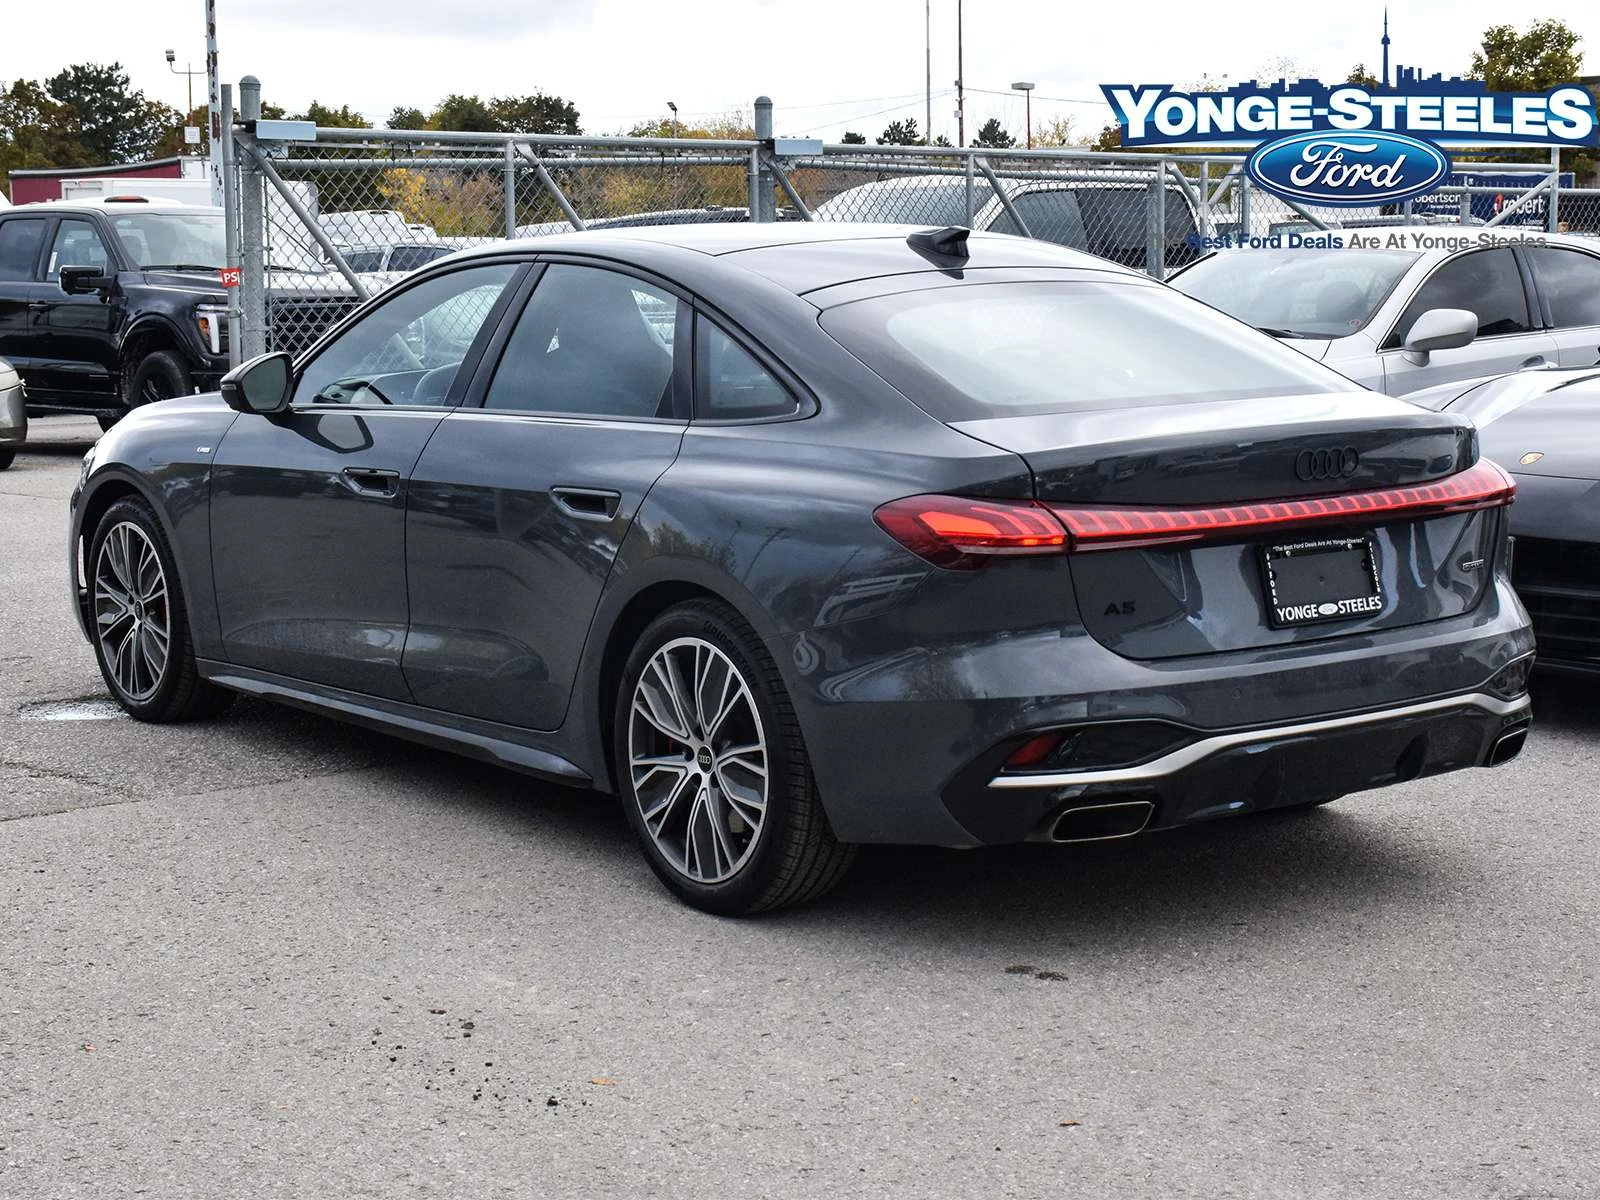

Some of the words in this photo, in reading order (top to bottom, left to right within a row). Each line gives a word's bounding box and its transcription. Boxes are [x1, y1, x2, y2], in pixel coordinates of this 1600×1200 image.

[1104, 601, 1136, 616] A5
[1277, 604, 1319, 621] YONGE
[1337, 596, 1382, 614] STEELES
